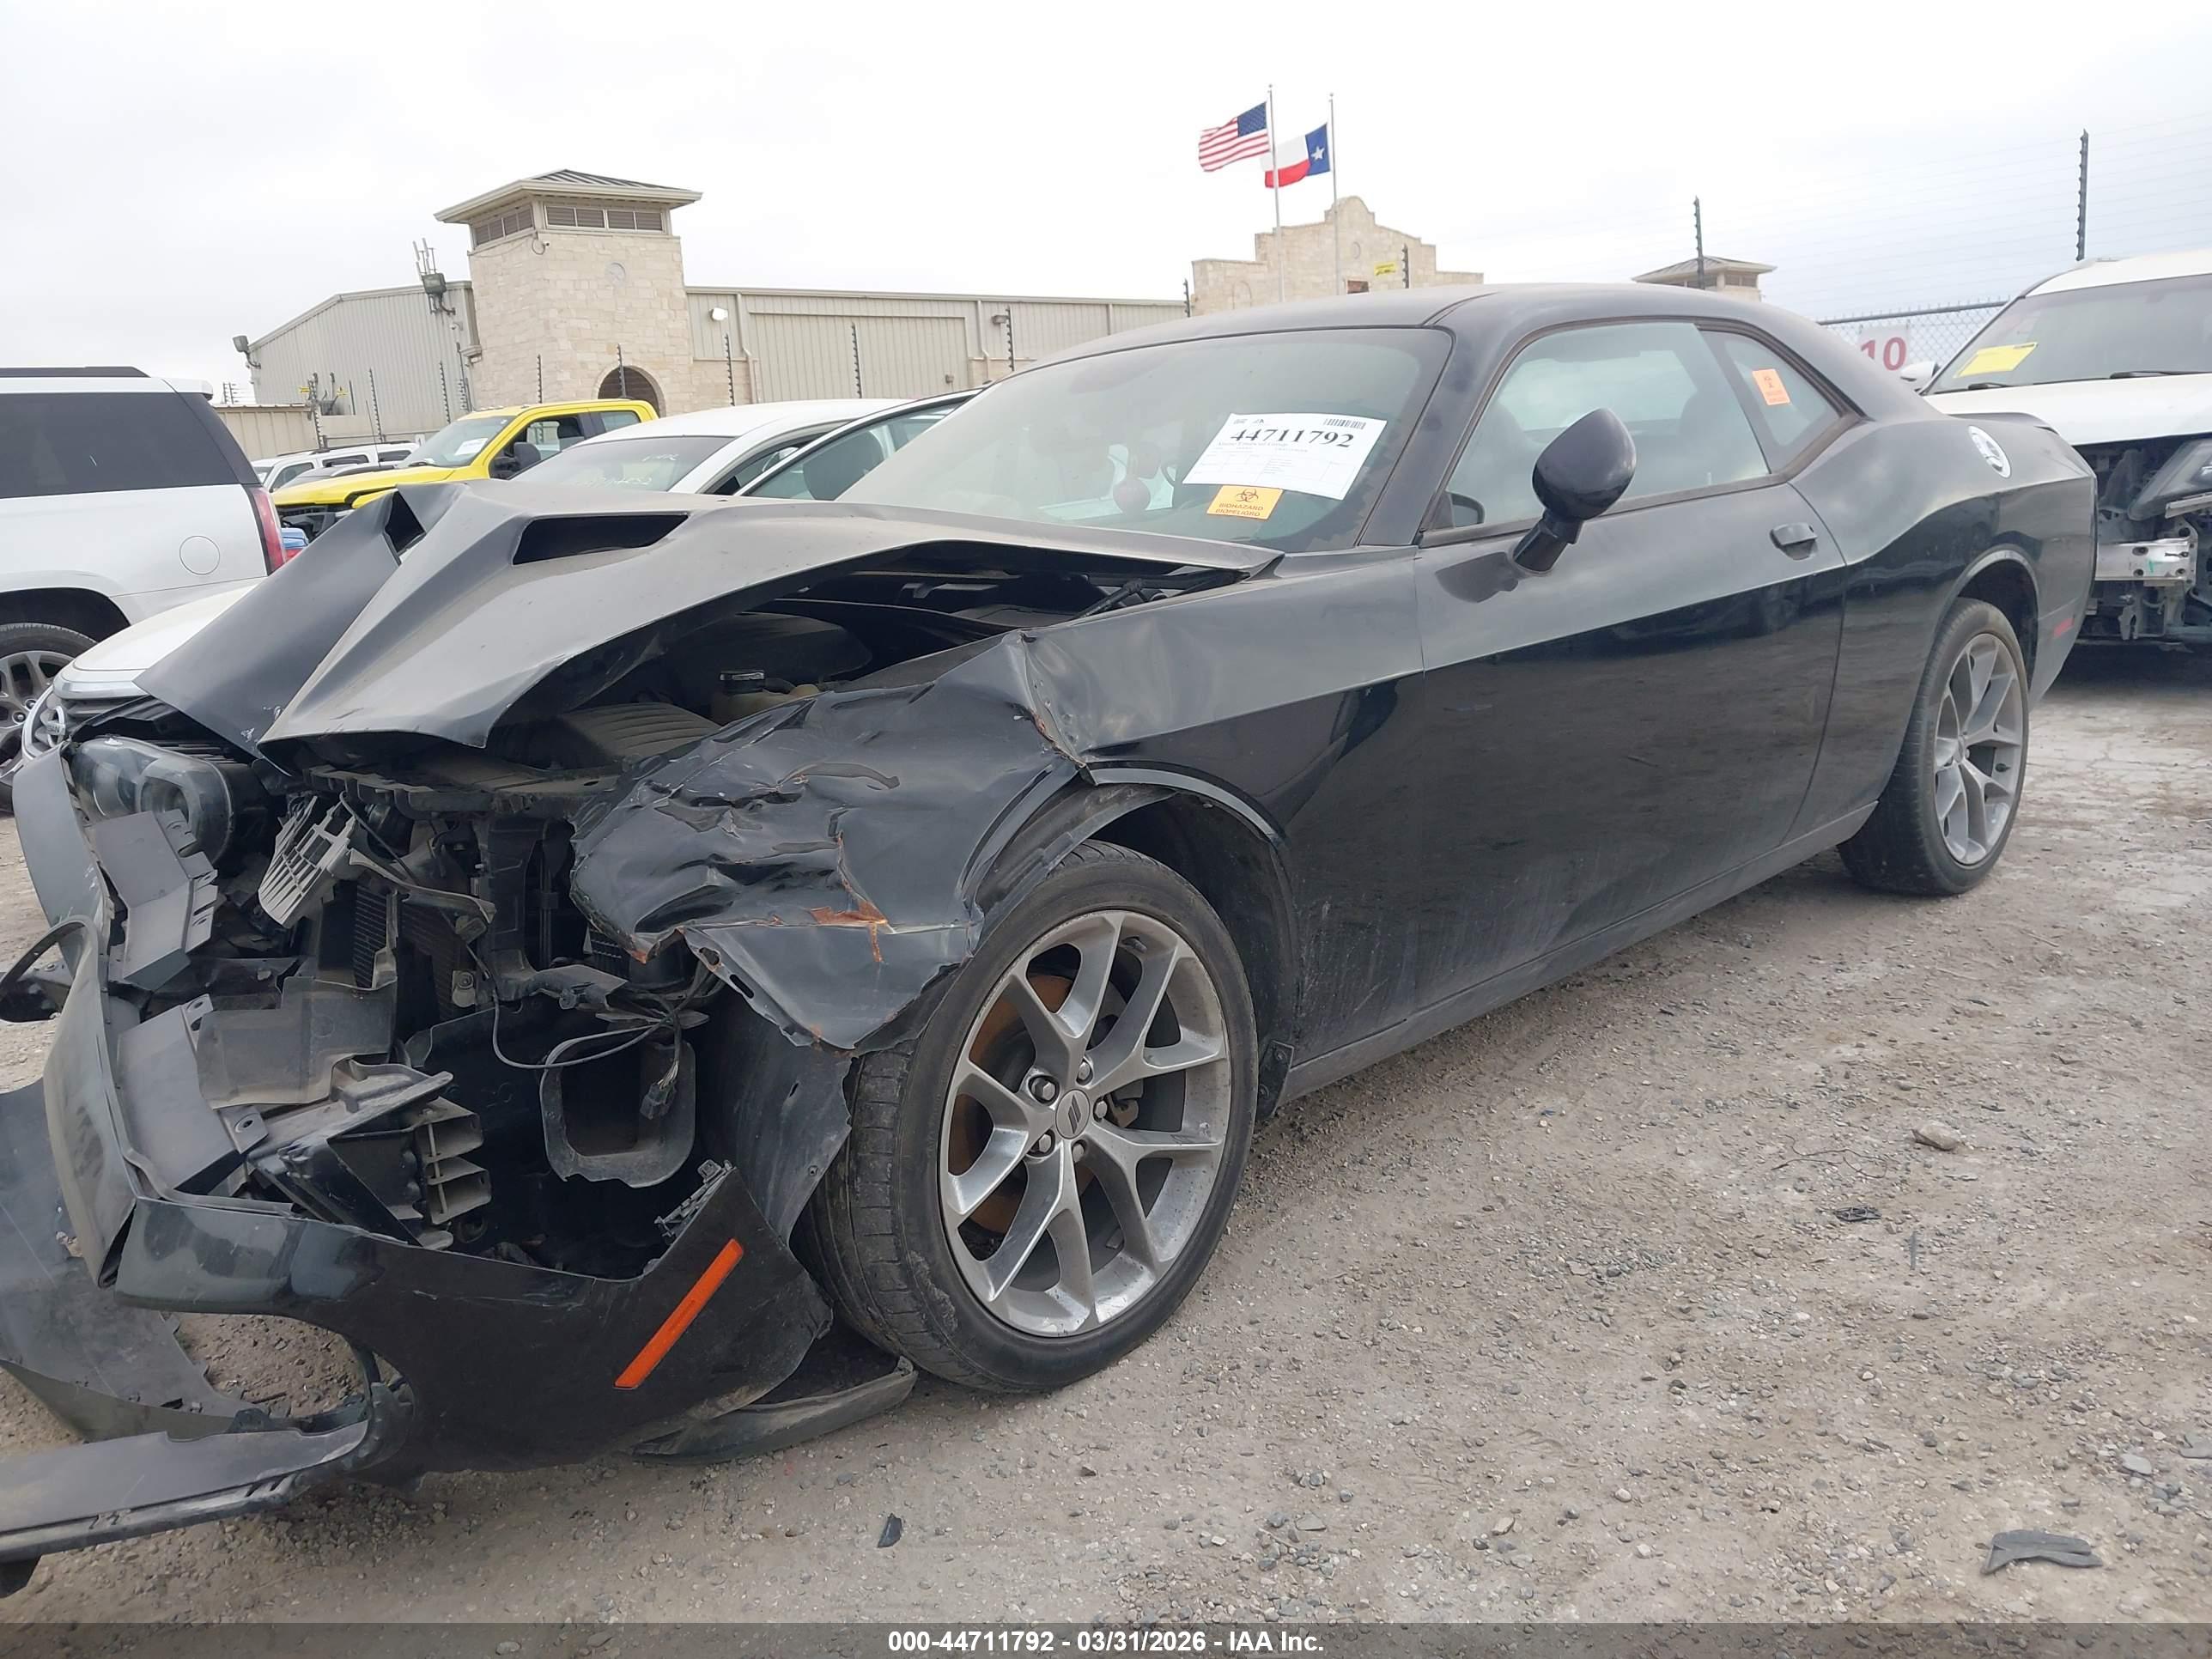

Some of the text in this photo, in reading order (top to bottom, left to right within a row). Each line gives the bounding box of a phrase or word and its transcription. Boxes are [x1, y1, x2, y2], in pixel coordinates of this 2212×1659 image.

[1861, 336, 1907, 371] 10
[1230, 428, 1354, 448] 44711792
[1215, 508, 1261, 517] BIOPELIGRO
[1218, 502, 1264, 511] BIOHAZARD
